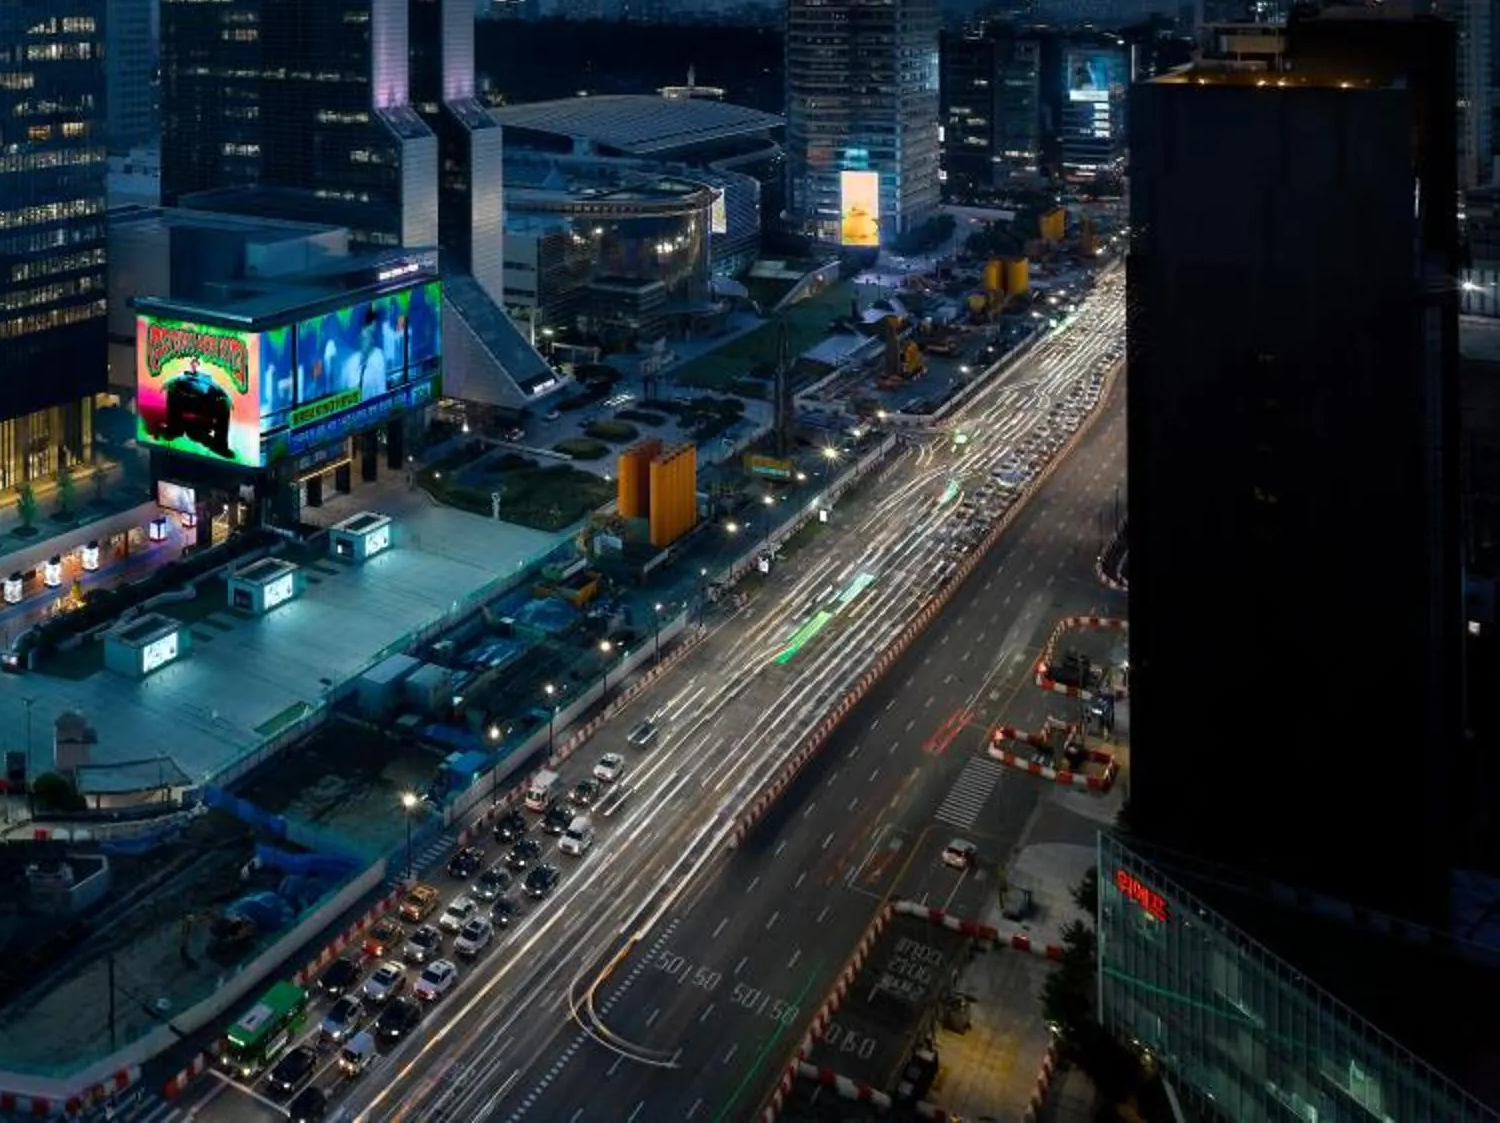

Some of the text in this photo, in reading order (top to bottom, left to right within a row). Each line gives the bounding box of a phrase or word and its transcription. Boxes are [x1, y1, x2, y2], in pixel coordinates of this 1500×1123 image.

[1117, 868, 1168, 923] 위메프
[654, 950, 685, 974] 50
[691, 965, 723, 991] 50
[730, 982, 762, 1008] 50
